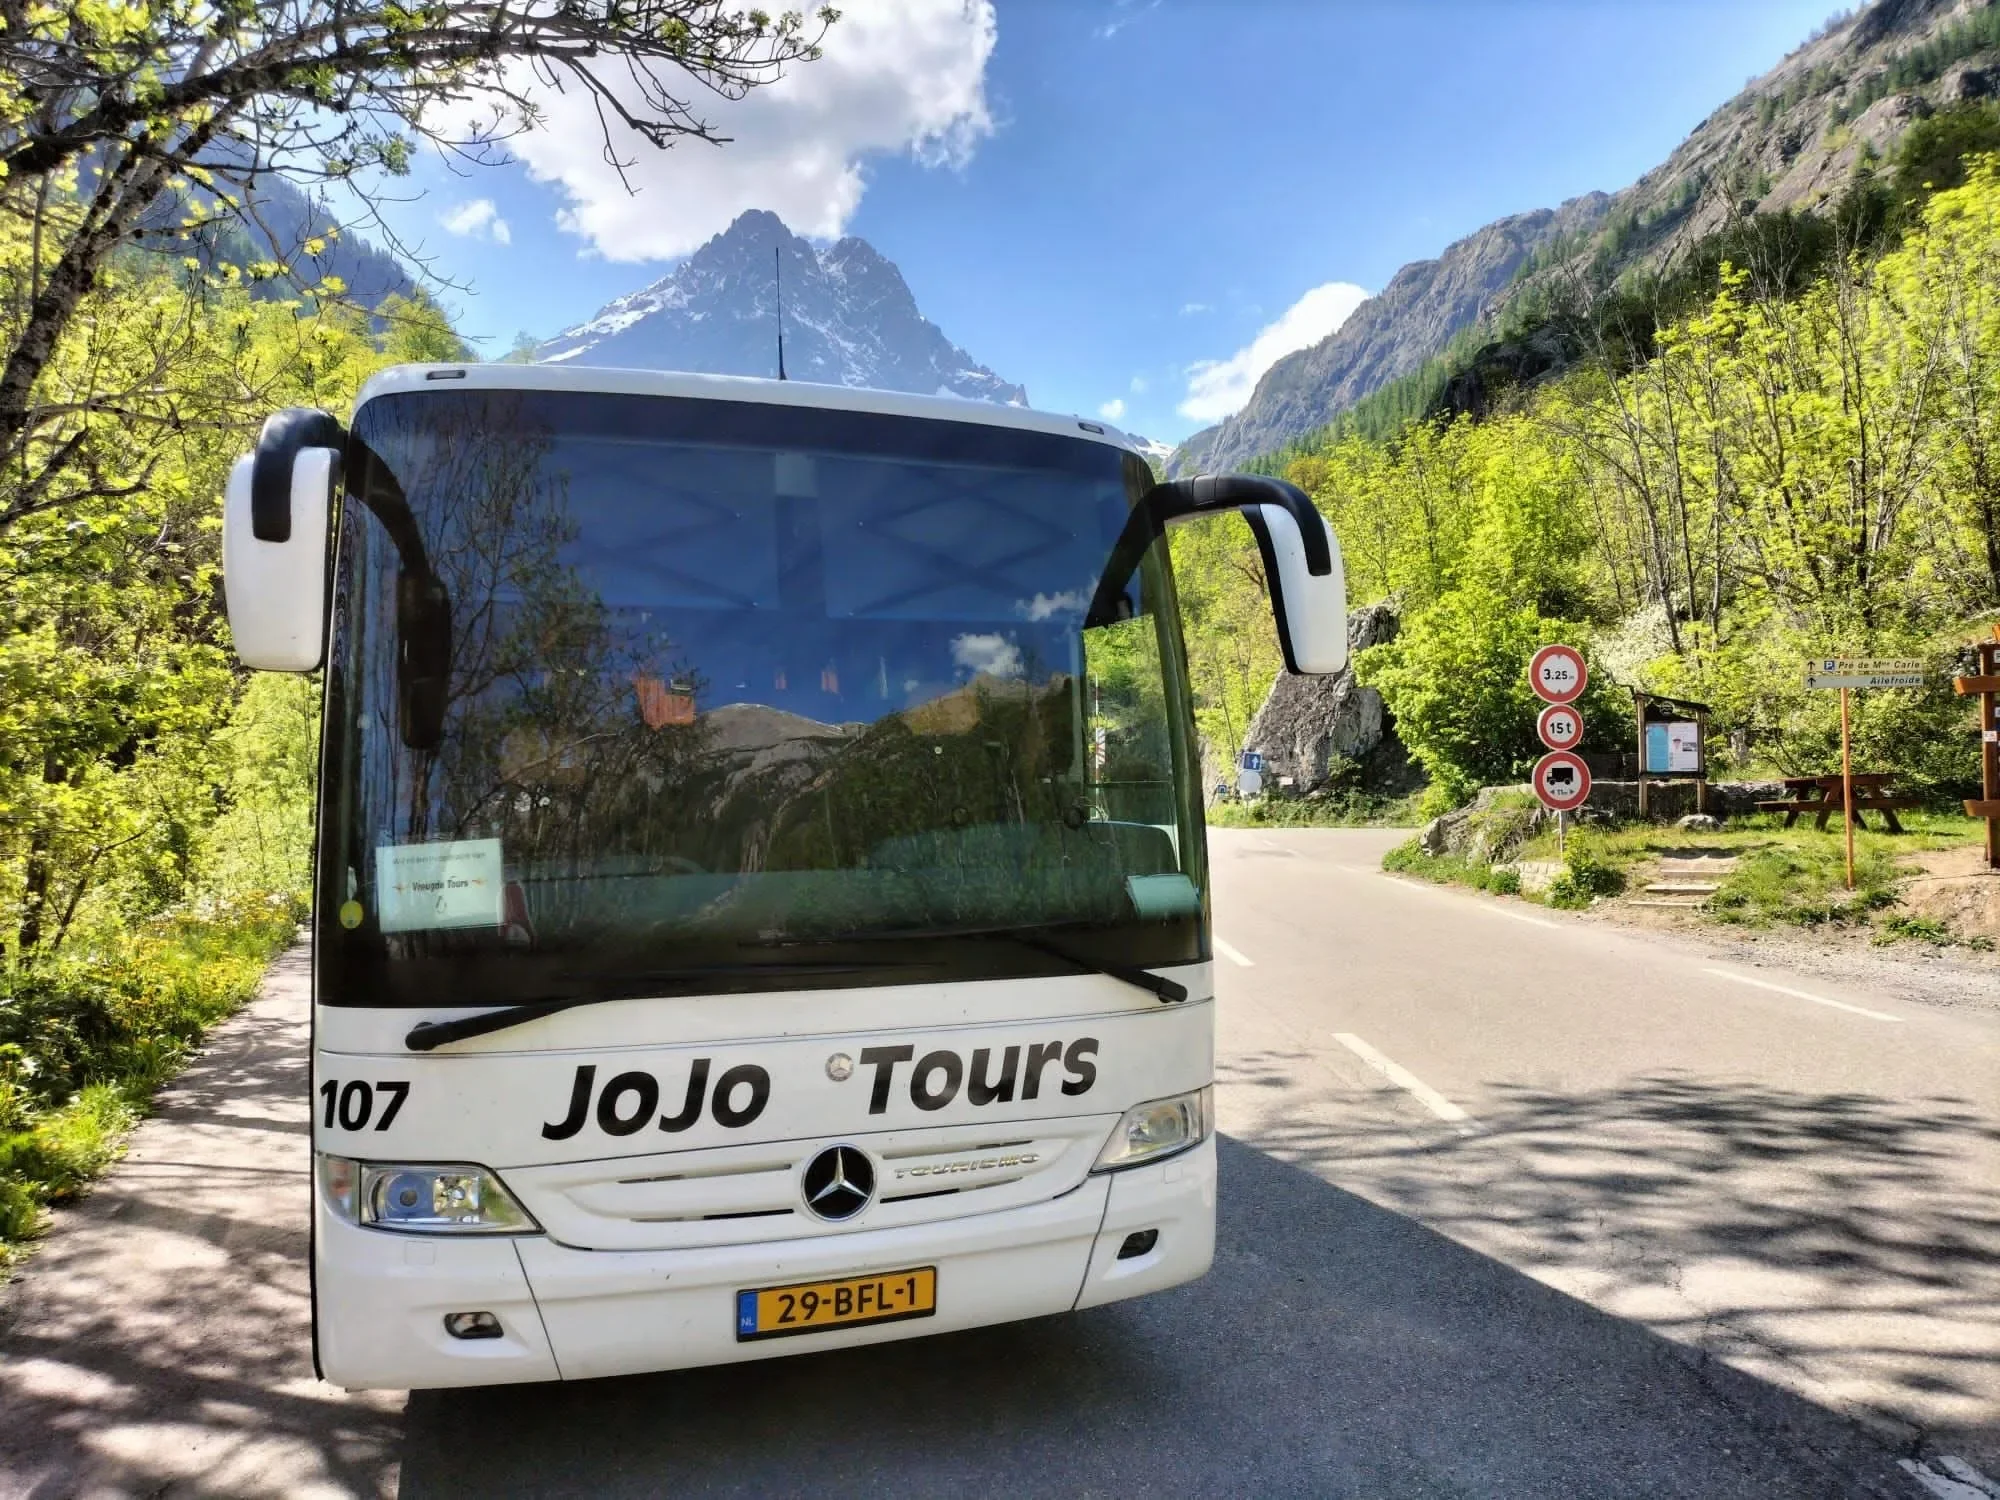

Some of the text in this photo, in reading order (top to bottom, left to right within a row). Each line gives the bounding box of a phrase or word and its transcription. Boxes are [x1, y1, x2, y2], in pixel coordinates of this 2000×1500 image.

[1858, 660, 1869, 668] de
[1870, 676, 1921, 685] Ailefroide
[447, 879, 469, 889] Tours
[541, 1037, 1100, 1140] JoJo Tours
[319, 1079, 411, 1132] 107
[778, 1277, 917, 1324] 29-BFL-1
[741, 1316, 754, 1327] NL
